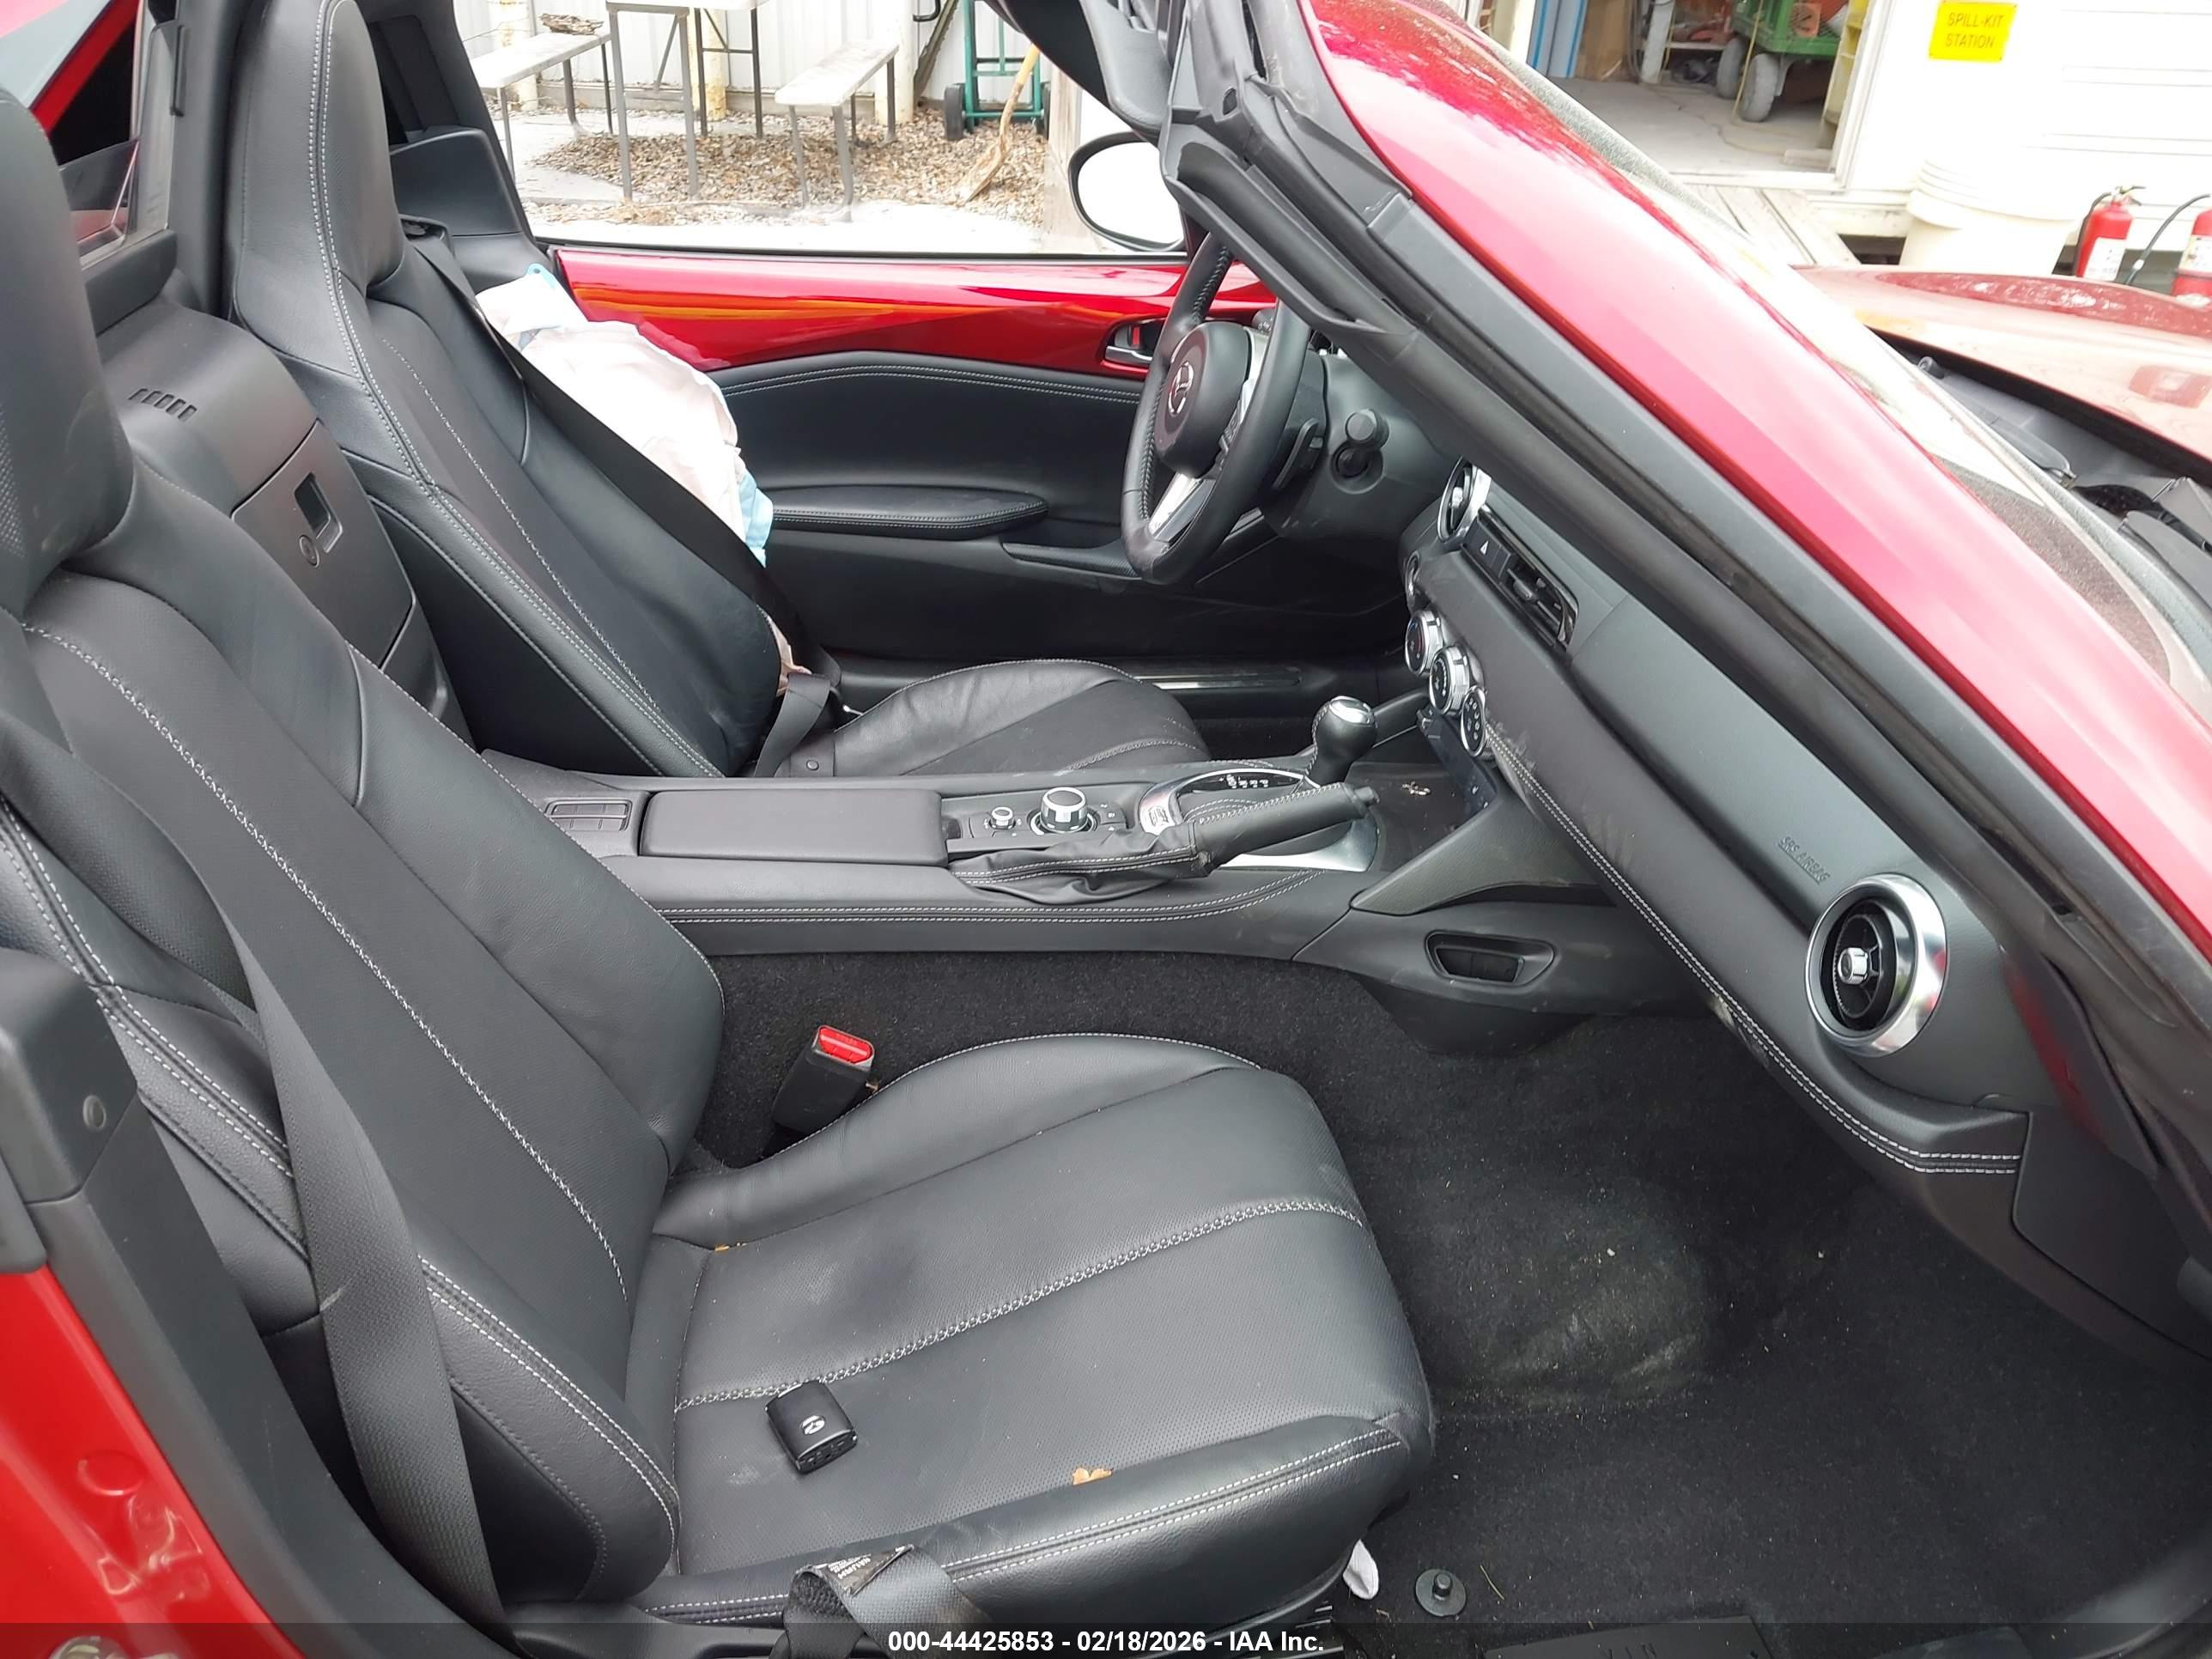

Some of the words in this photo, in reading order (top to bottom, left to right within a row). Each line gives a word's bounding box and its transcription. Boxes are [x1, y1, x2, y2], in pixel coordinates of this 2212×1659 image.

[1945, 33, 1996, 48] STATION
[1778, 836, 1801, 853] SRS
[1795, 852, 1831, 883] AIRBAG
